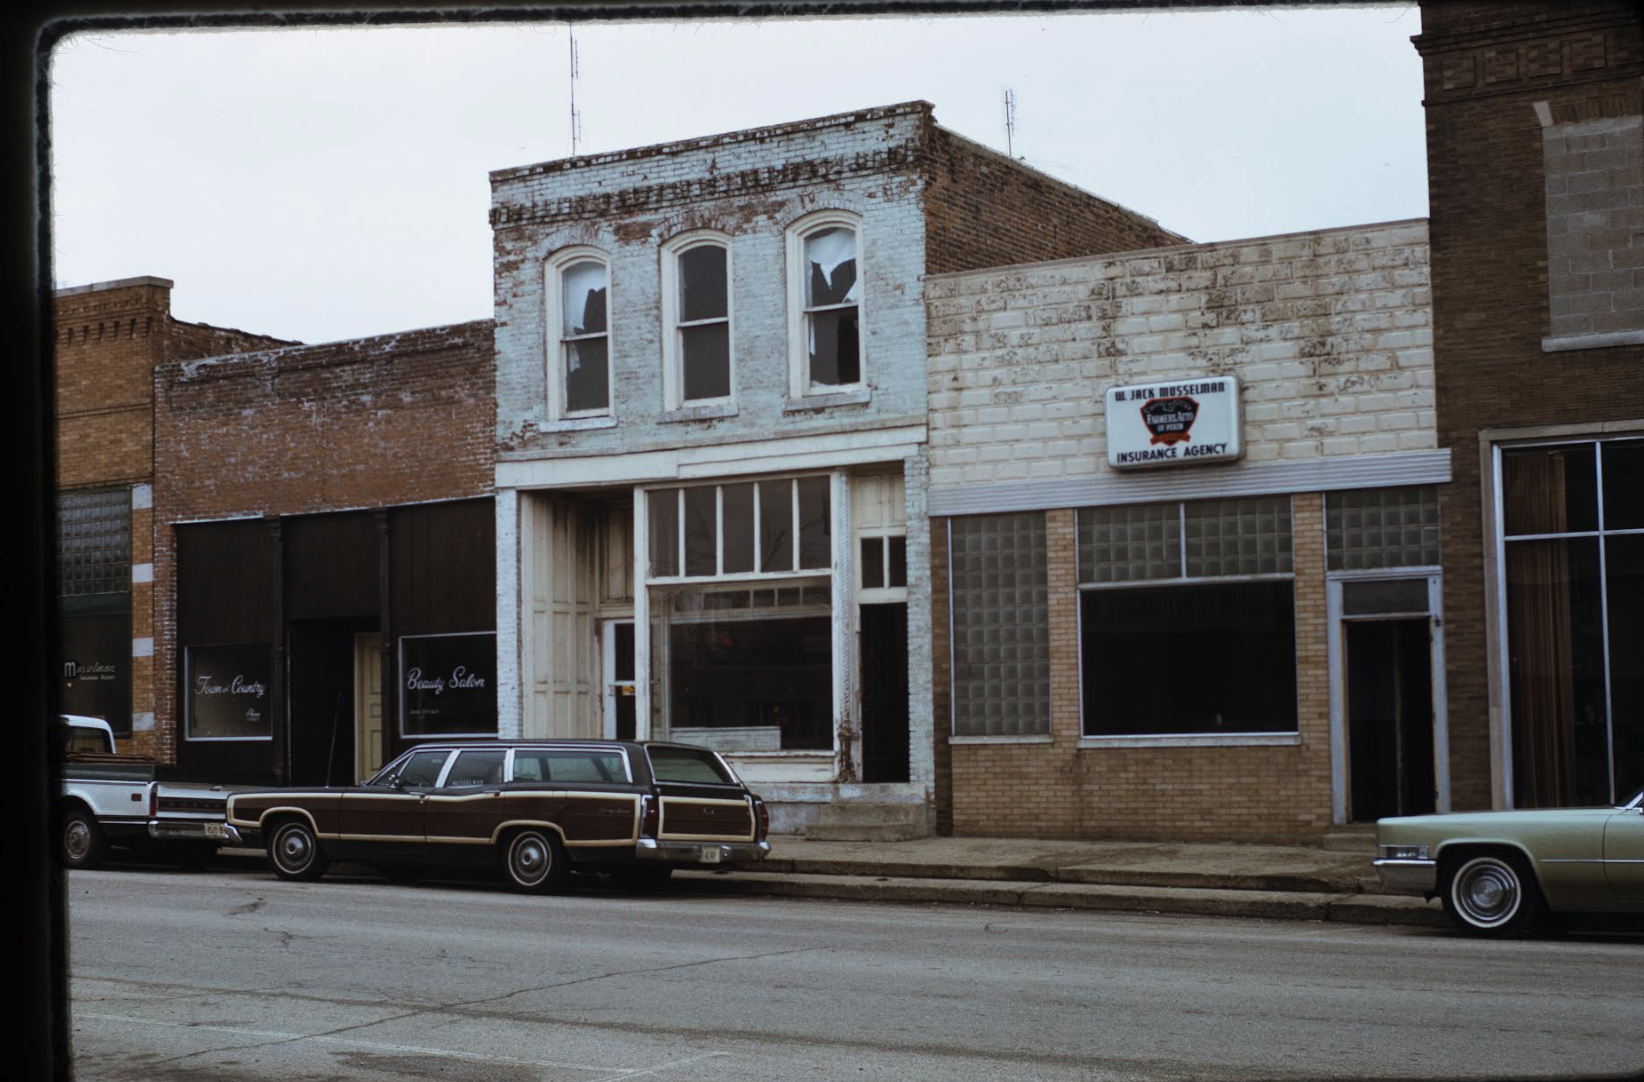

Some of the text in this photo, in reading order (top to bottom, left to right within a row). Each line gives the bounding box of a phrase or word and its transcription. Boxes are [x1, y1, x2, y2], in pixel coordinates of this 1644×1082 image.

[1115, 382, 1225, 401] W. JACK MUSSELMAN
[1117, 443, 1227, 463] INSURANCE AGENCY
[194, 675, 222, 694] Town
[231, 674, 266, 699] Country
[407, 665, 486, 695] Beauty Salon
